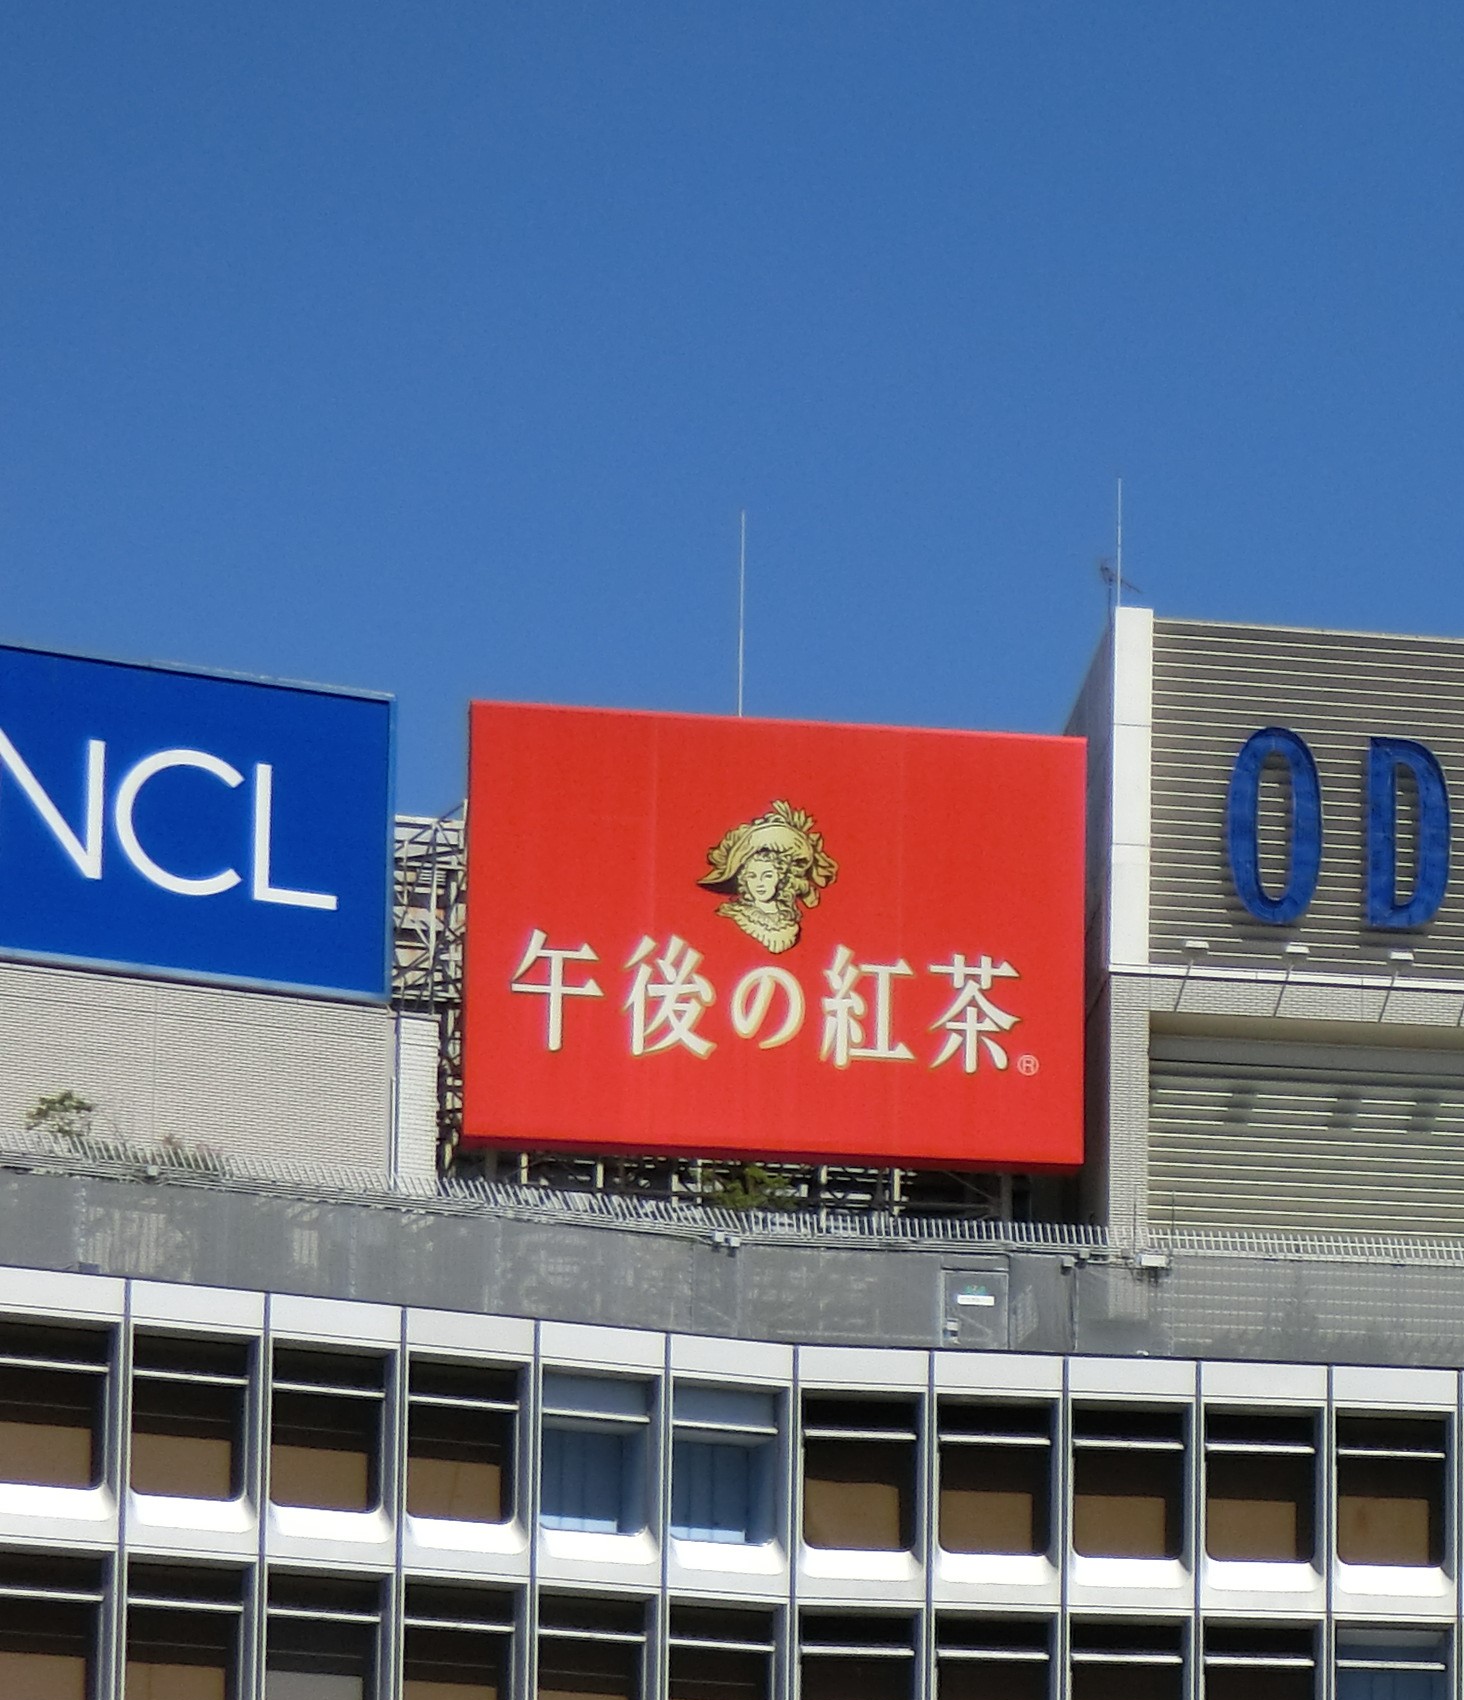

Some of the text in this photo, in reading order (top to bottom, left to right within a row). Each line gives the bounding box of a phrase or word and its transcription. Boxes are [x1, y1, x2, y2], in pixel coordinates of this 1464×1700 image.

[510, 928, 1021, 1075] 午後の紅茶
